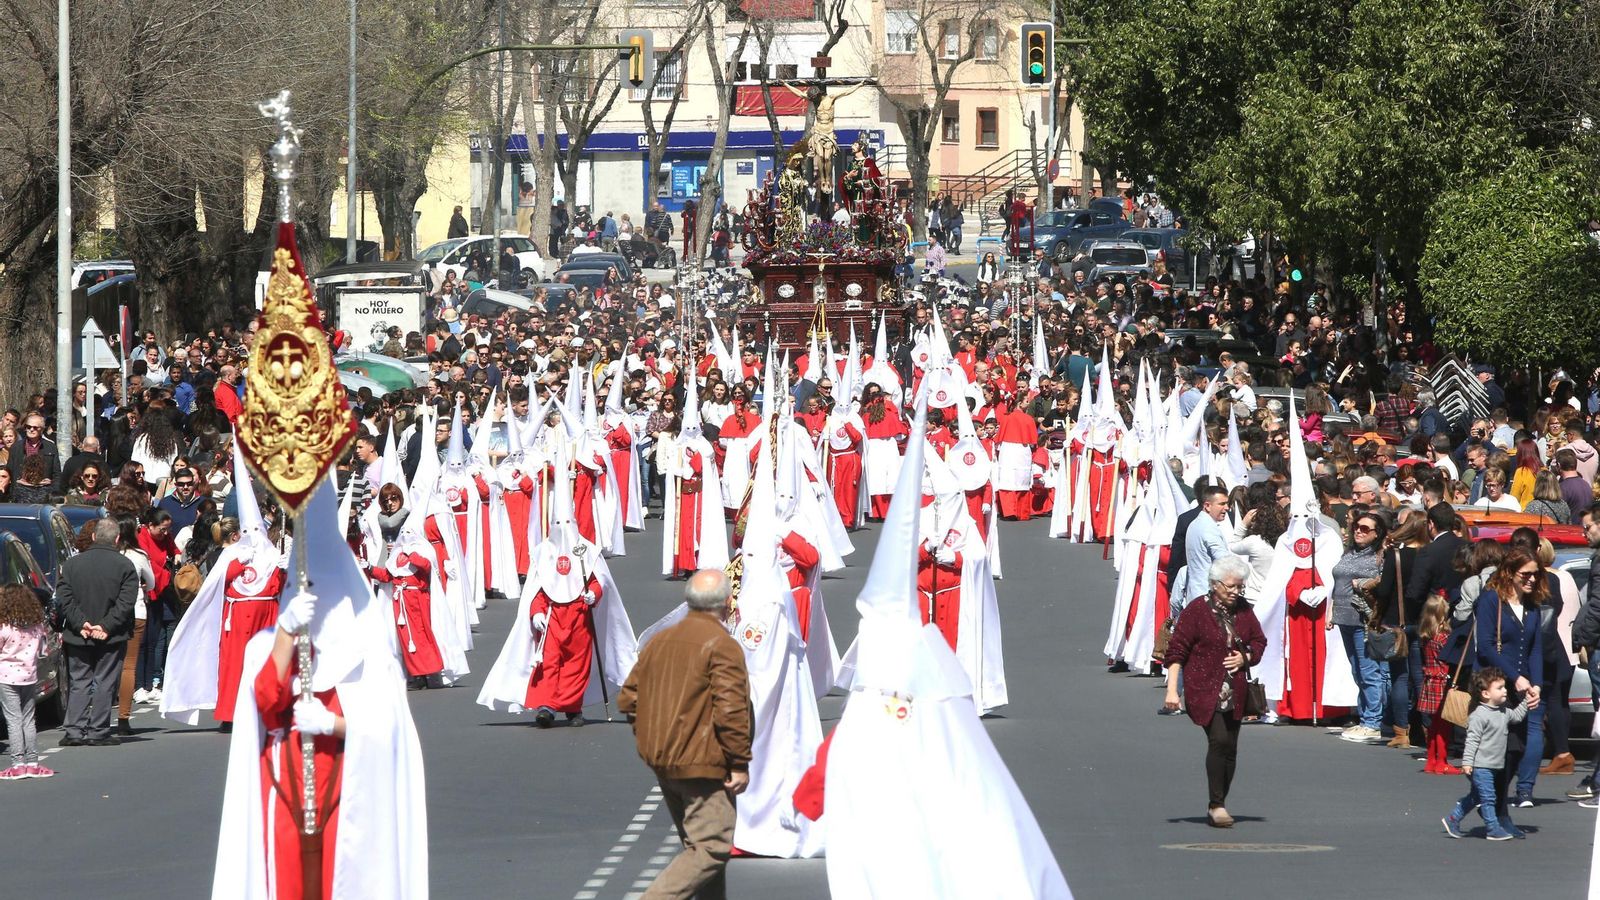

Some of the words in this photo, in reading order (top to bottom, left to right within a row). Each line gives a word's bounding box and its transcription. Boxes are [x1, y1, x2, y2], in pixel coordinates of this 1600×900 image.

[369, 300, 389, 308] HOY
[354, 307, 370, 315] NO
[372, 307, 404, 315] MUERO
